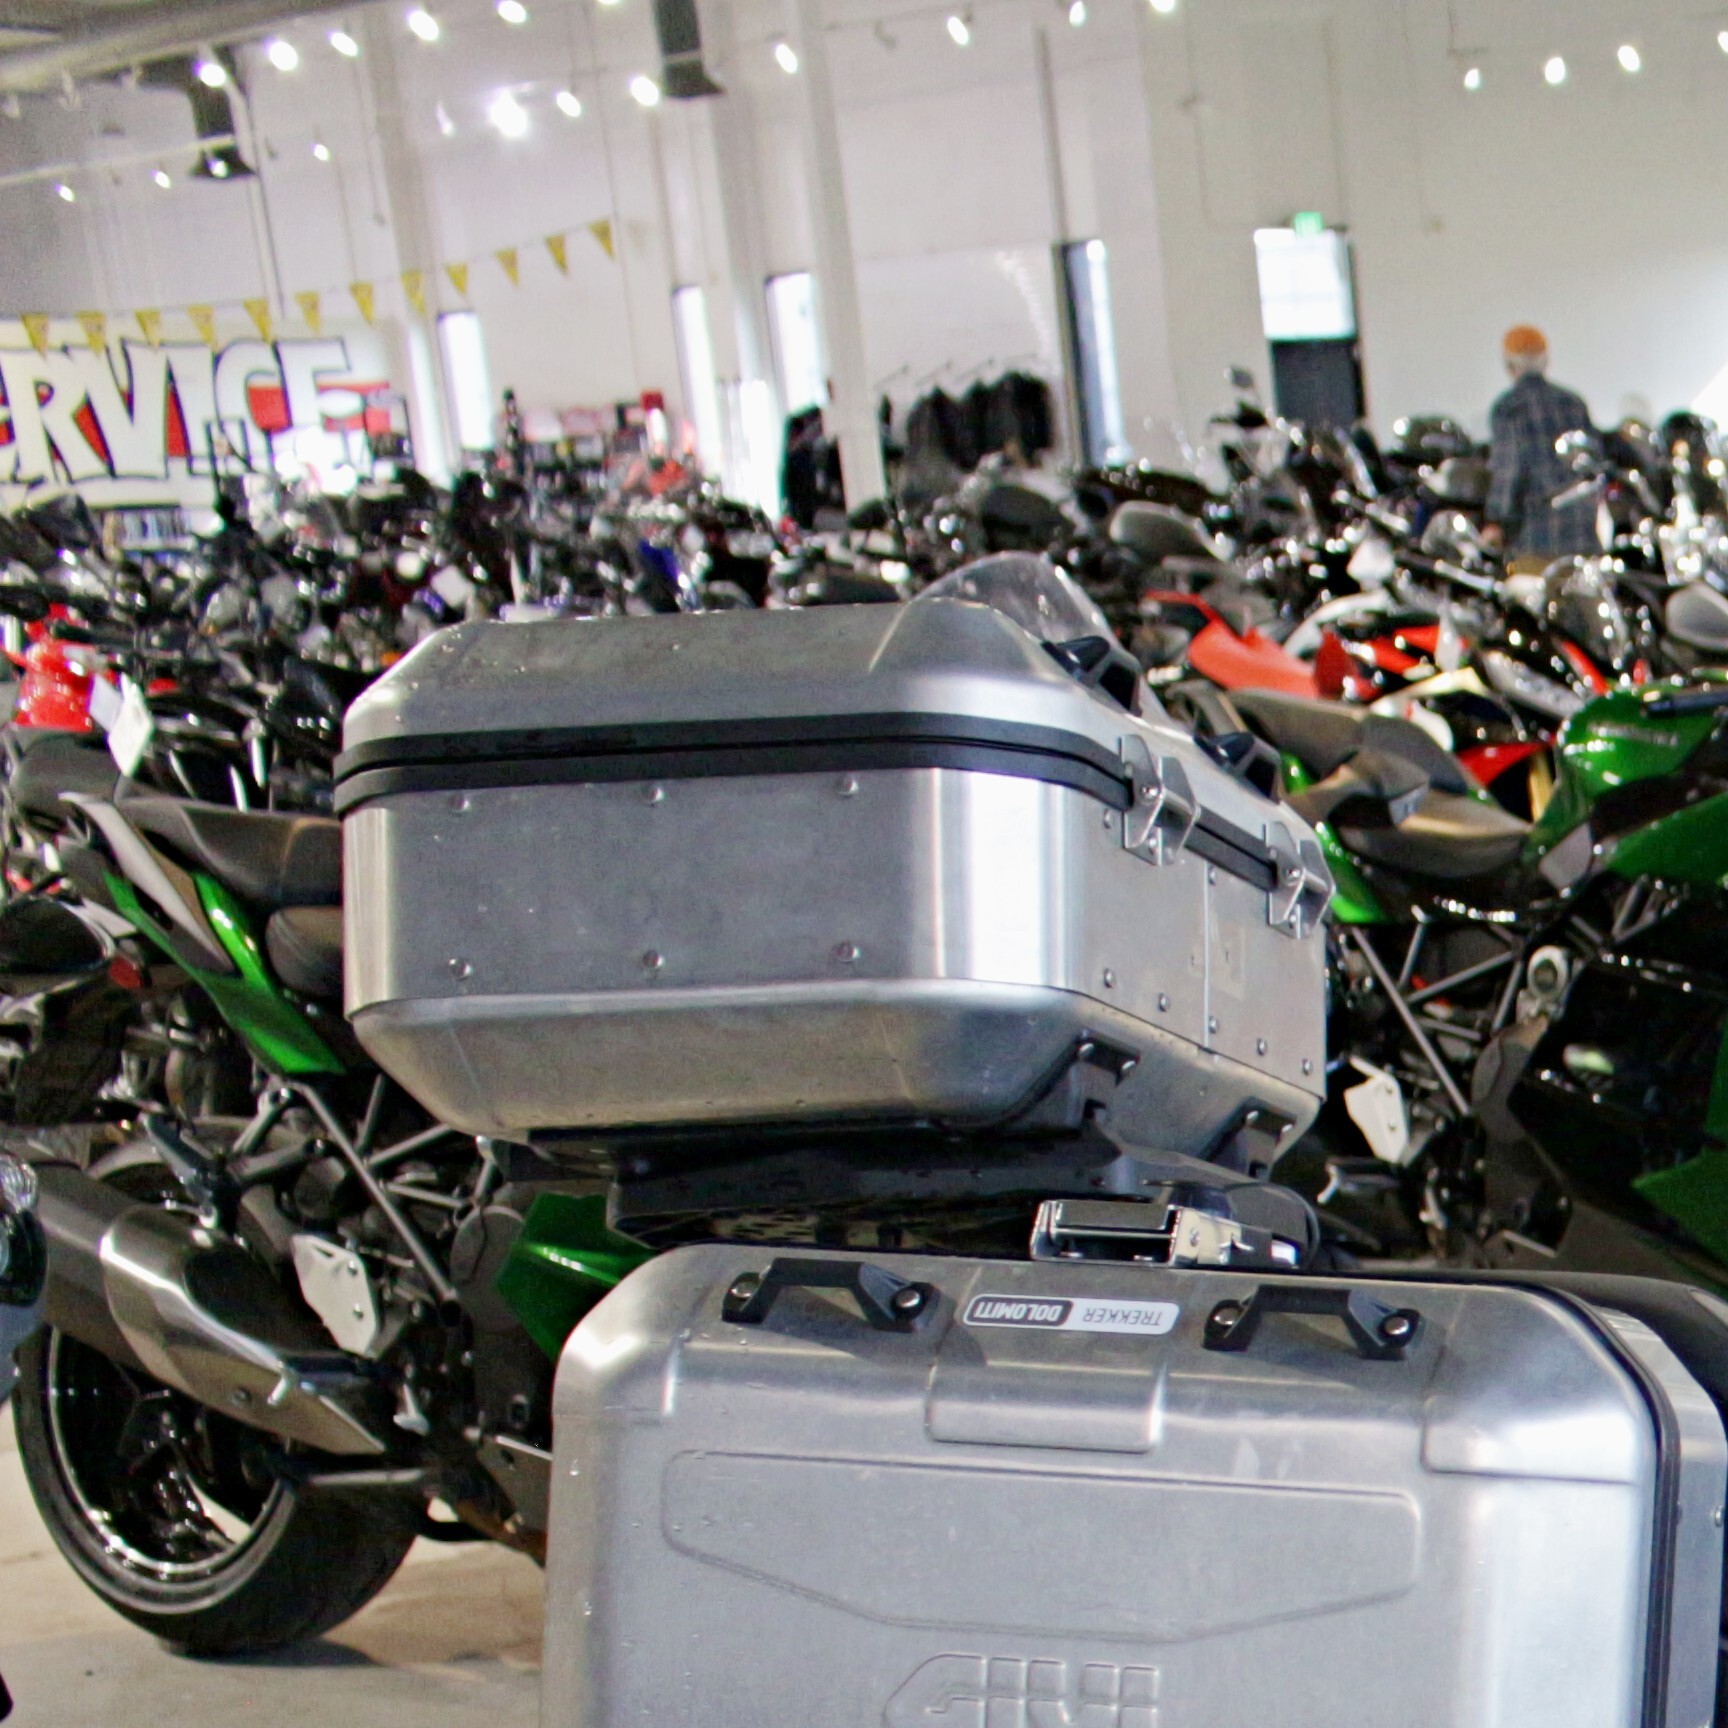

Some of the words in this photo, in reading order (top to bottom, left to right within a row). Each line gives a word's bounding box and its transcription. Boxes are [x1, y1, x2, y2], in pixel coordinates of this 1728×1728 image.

[0, 336, 368, 482] RVICE
[973, 1300, 1065, 1322] DOLOMITI
[1081, 1306, 1164, 1327] TREKKER
